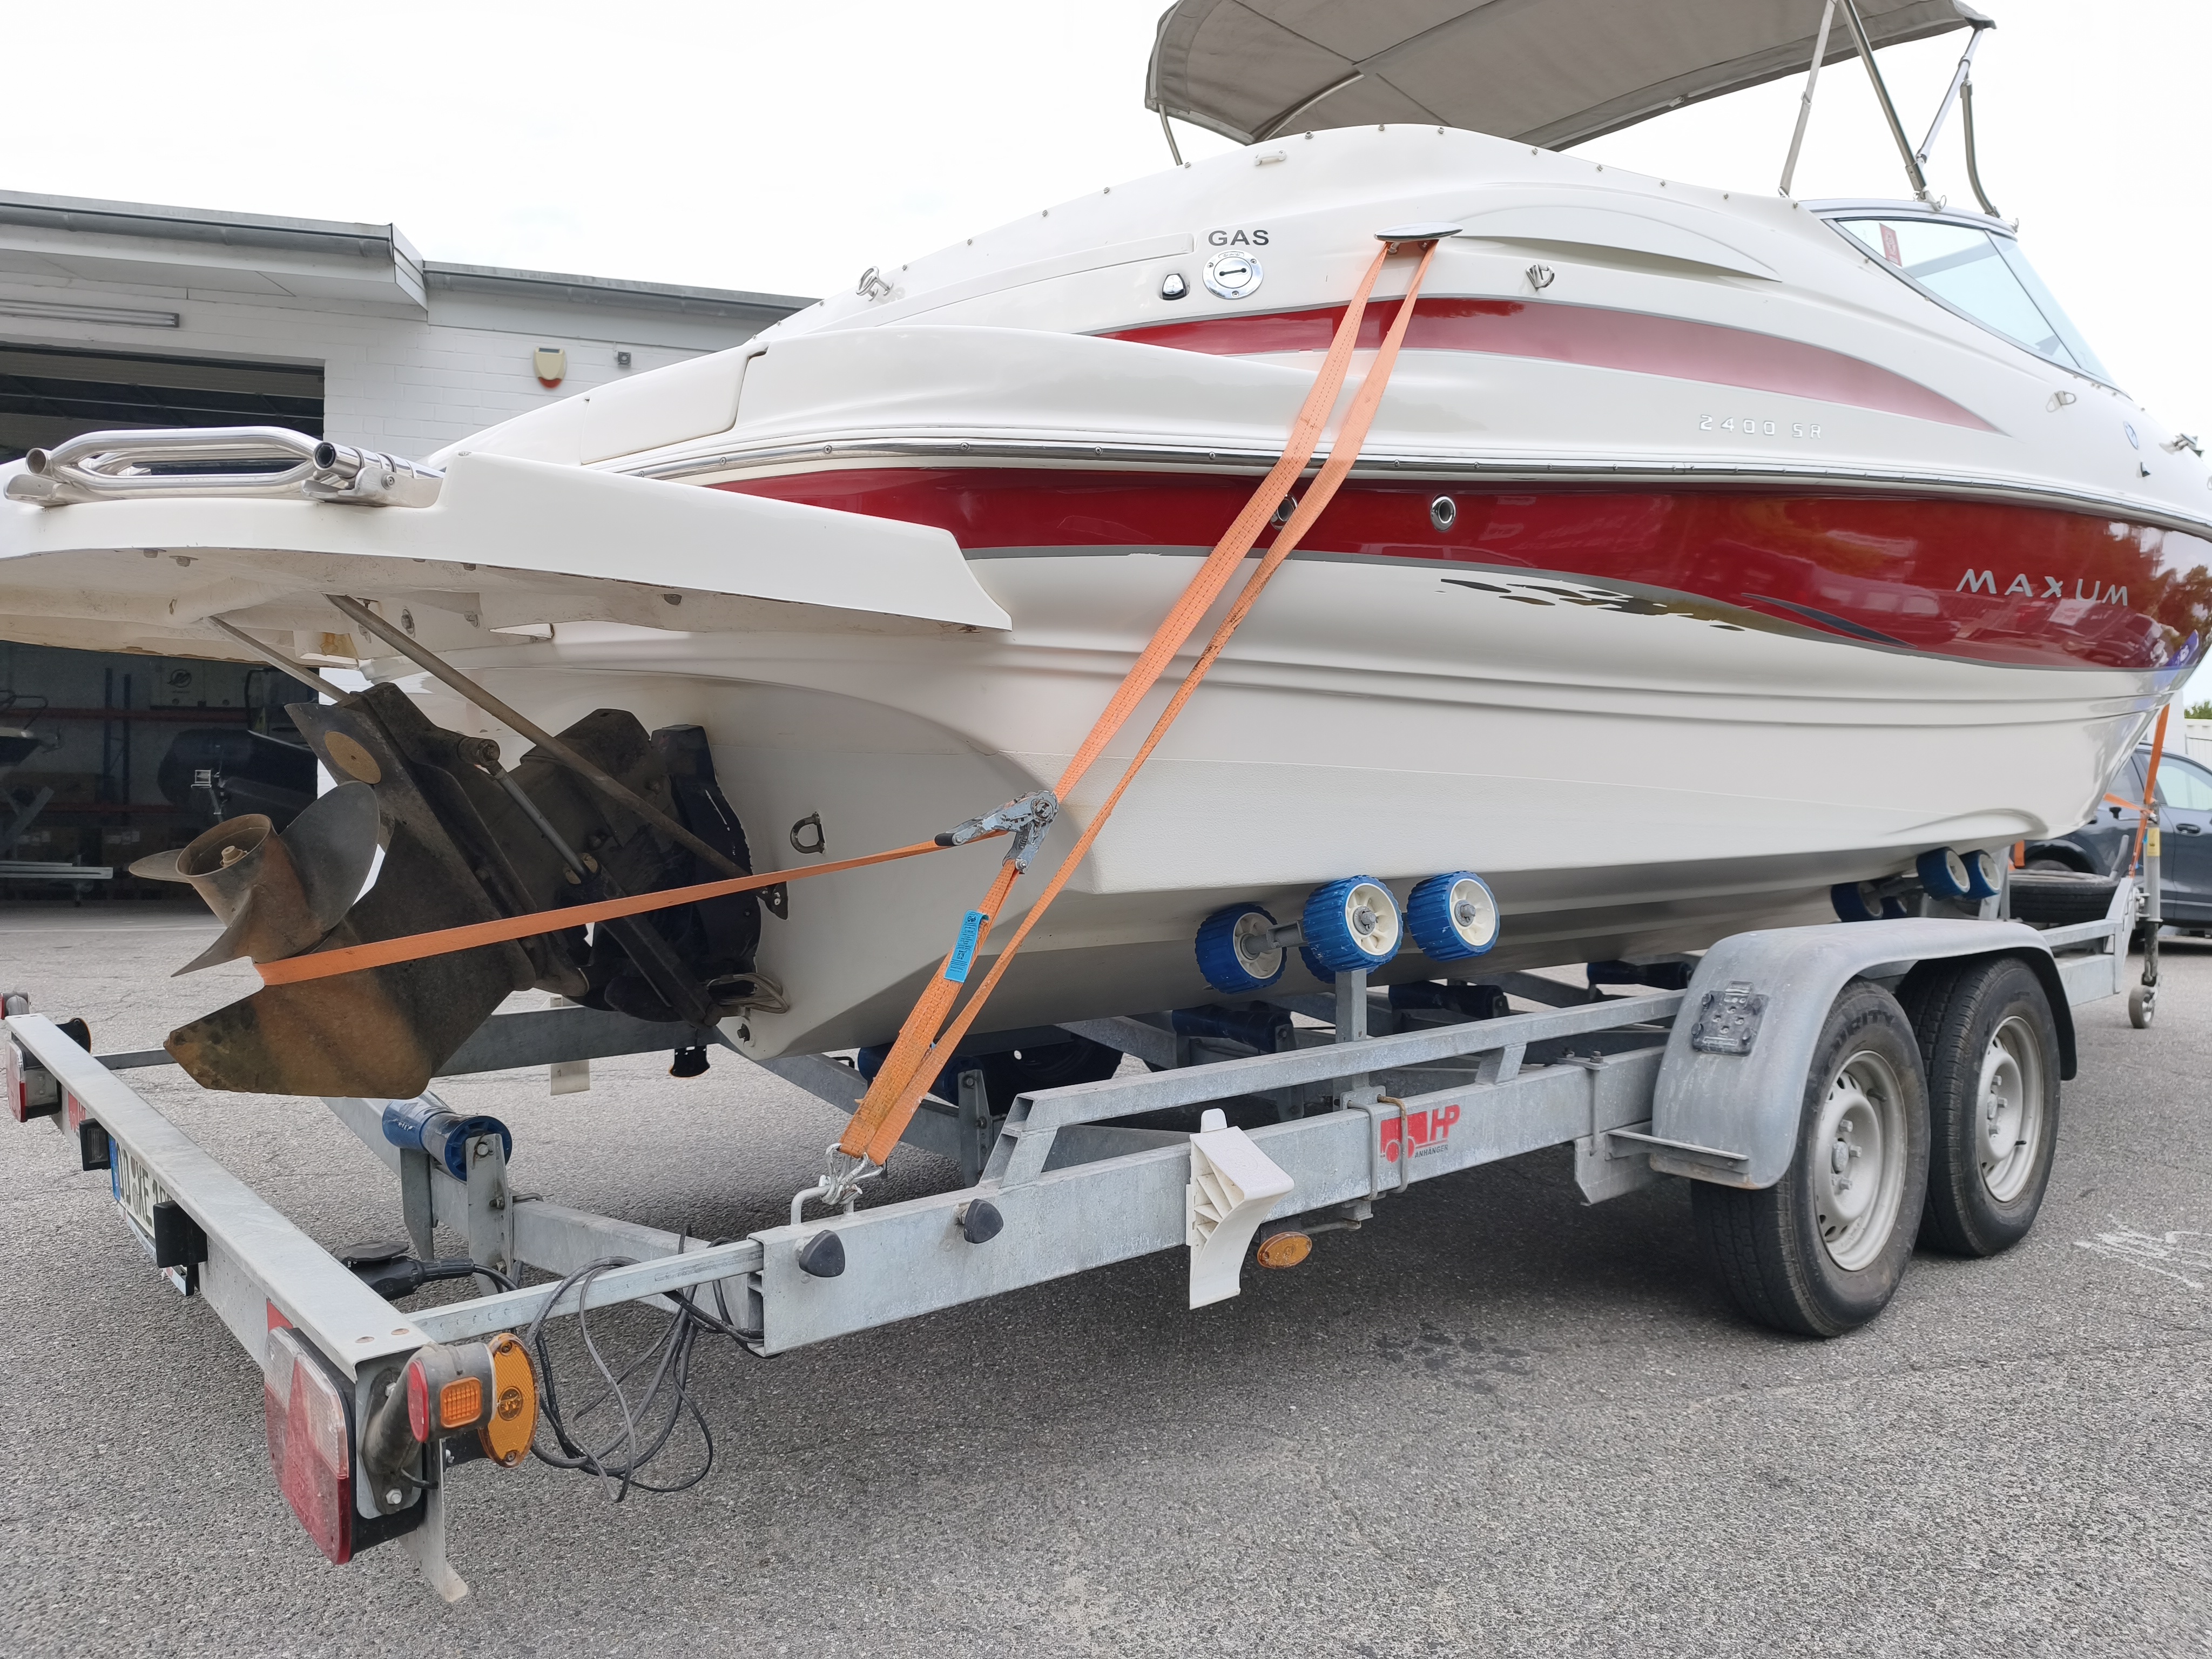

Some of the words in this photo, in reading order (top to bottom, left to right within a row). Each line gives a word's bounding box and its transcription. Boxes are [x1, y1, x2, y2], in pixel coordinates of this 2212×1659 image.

[1208, 230, 1269, 246] GAS
[1700, 414, 1776, 435] 2400
[1792, 423, 1821, 439] SR
[1955, 569, 2128, 606] MAXUM
[1430, 1104, 1461, 1141] HP
